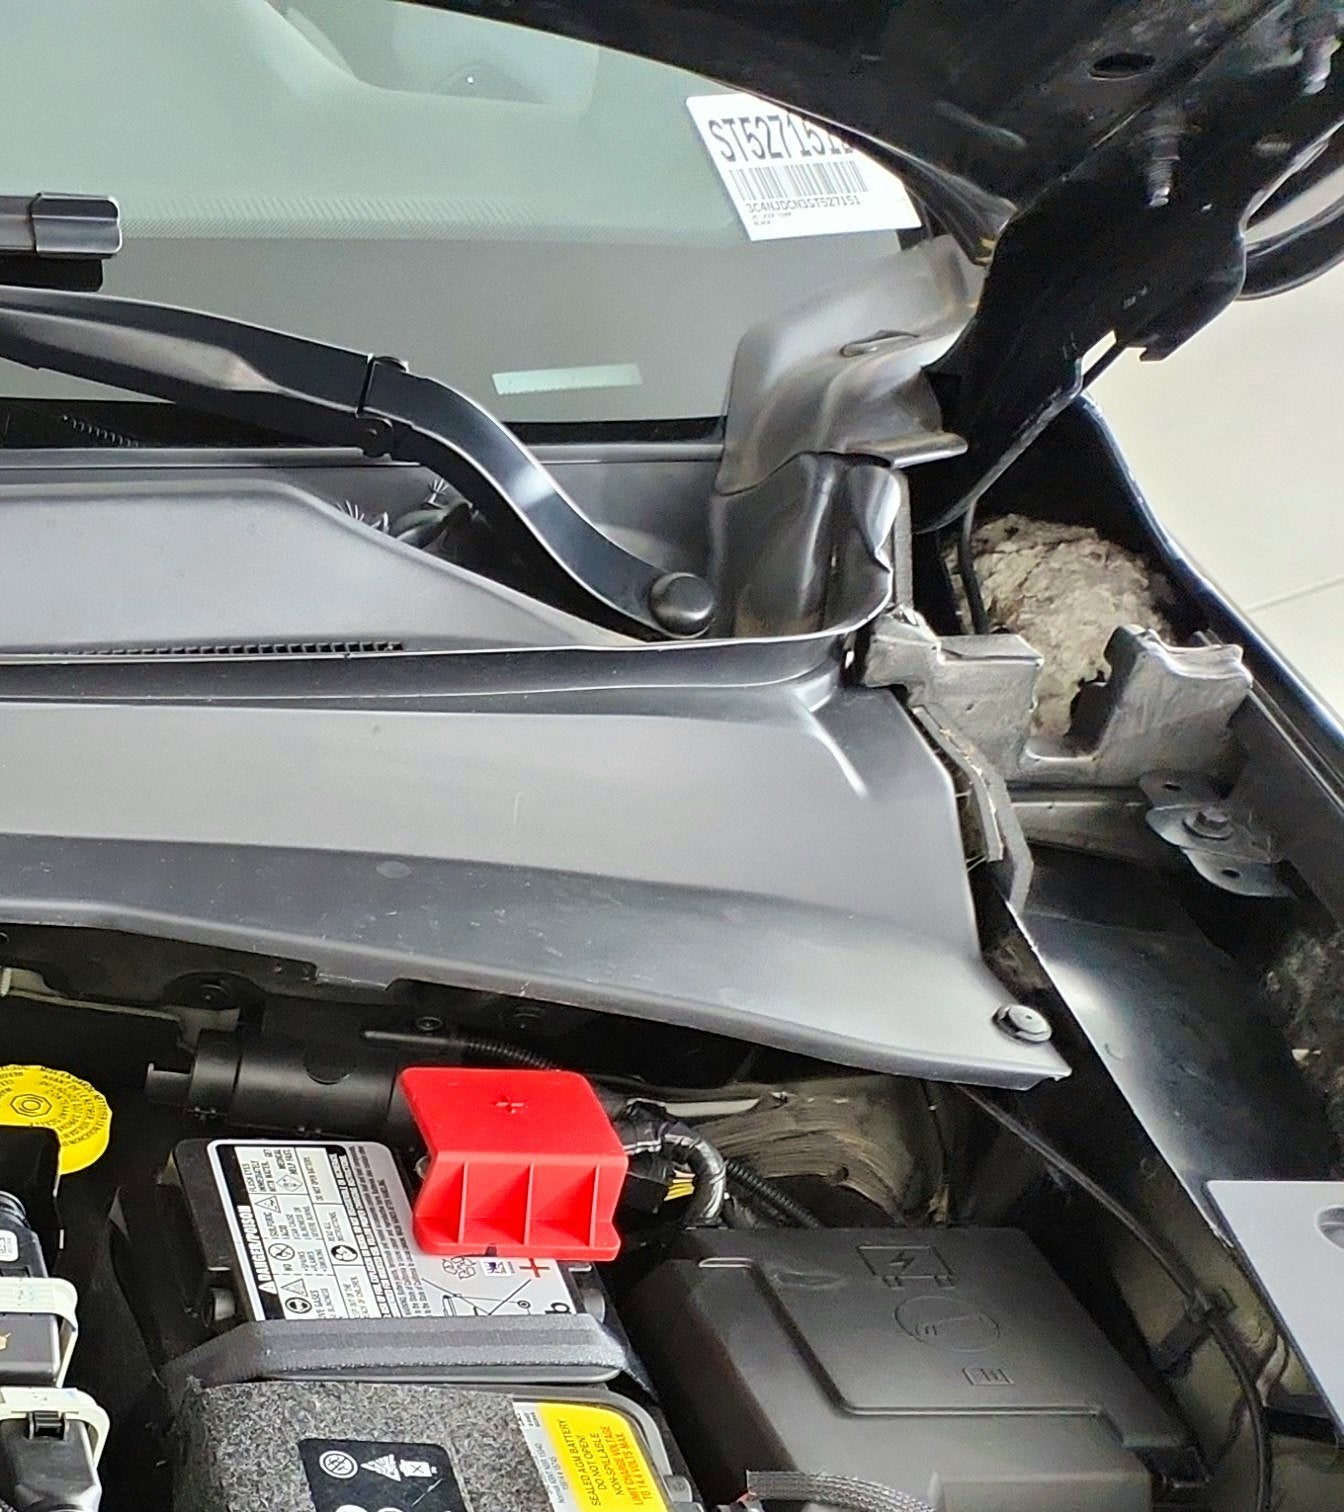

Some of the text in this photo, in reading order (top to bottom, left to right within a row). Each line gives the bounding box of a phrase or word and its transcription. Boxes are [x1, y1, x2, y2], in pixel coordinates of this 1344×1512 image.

[242, 1163, 252, 1176] EYES
[237, 1204, 272, 1281] DANGER/POISON
[556, 1419, 602, 1506] SEALED AGM BATTERY
[587, 1460, 602, 1477] NOT
[589, 1432, 625, 1495] NON-SPILLABLE
[599, 1426, 644, 1506] LIMIT CHARGE VOLTAGE
[623, 1450, 640, 1473] VOLTS
[595, 1478, 608, 1490] DO
[640, 1490, 653, 1500] TO
